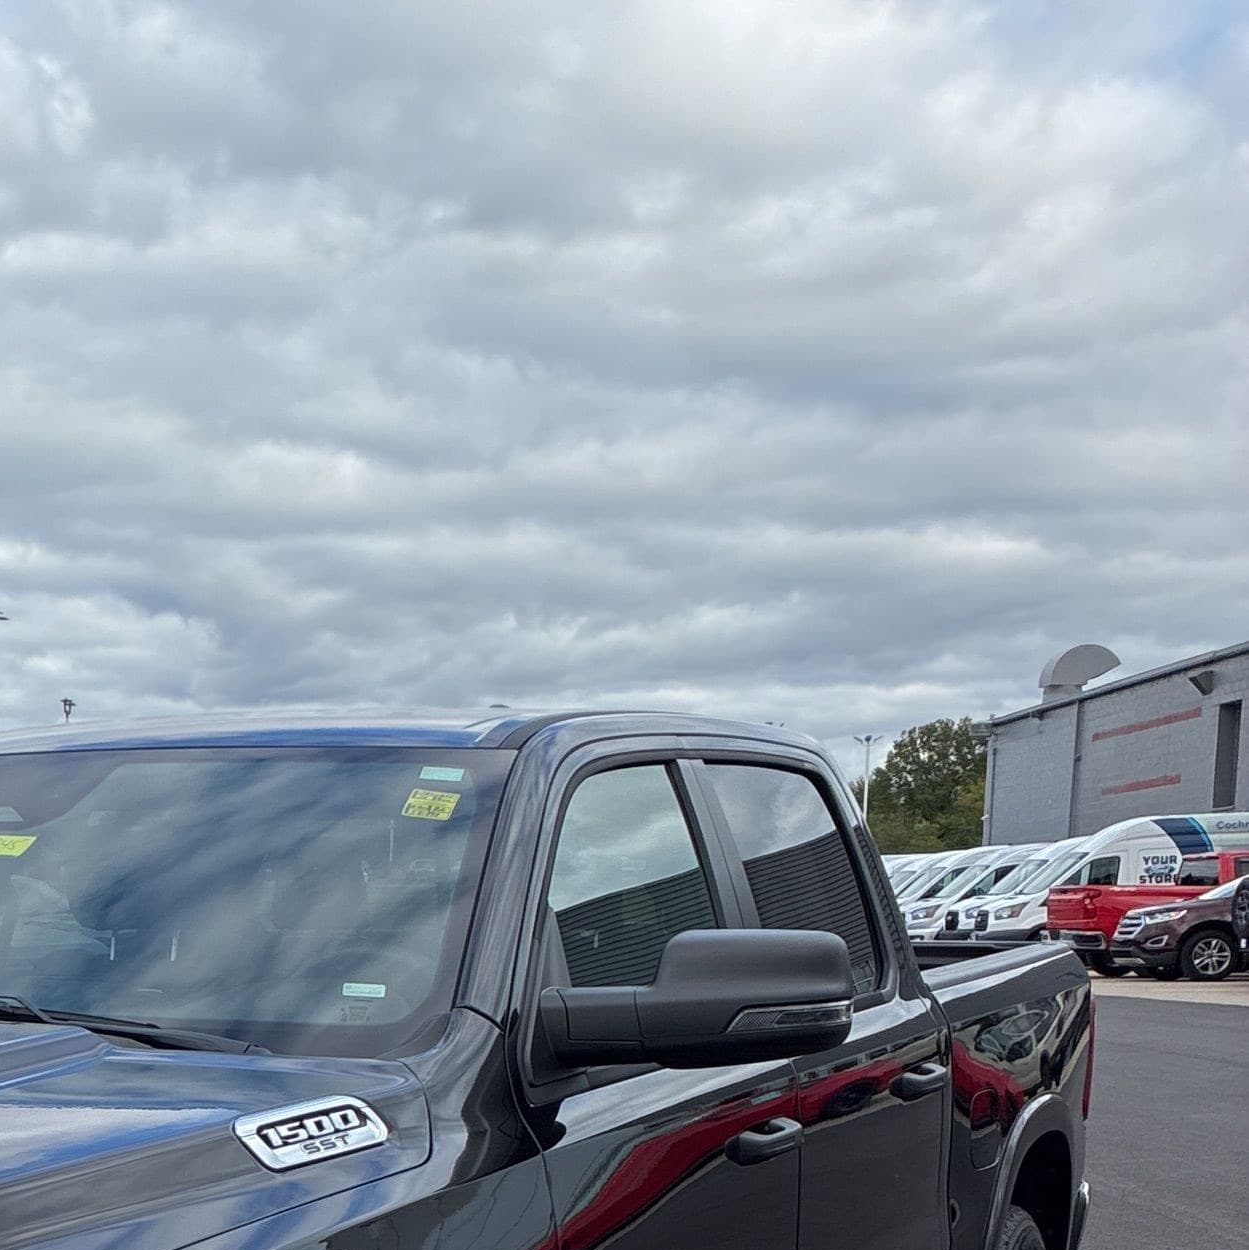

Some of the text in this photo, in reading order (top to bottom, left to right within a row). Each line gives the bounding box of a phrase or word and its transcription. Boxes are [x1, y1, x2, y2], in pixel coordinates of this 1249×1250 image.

[1142, 855, 1178, 865] YOUR
[259, 1108, 361, 1148] 1500
[301, 1133, 351, 1155] SST
